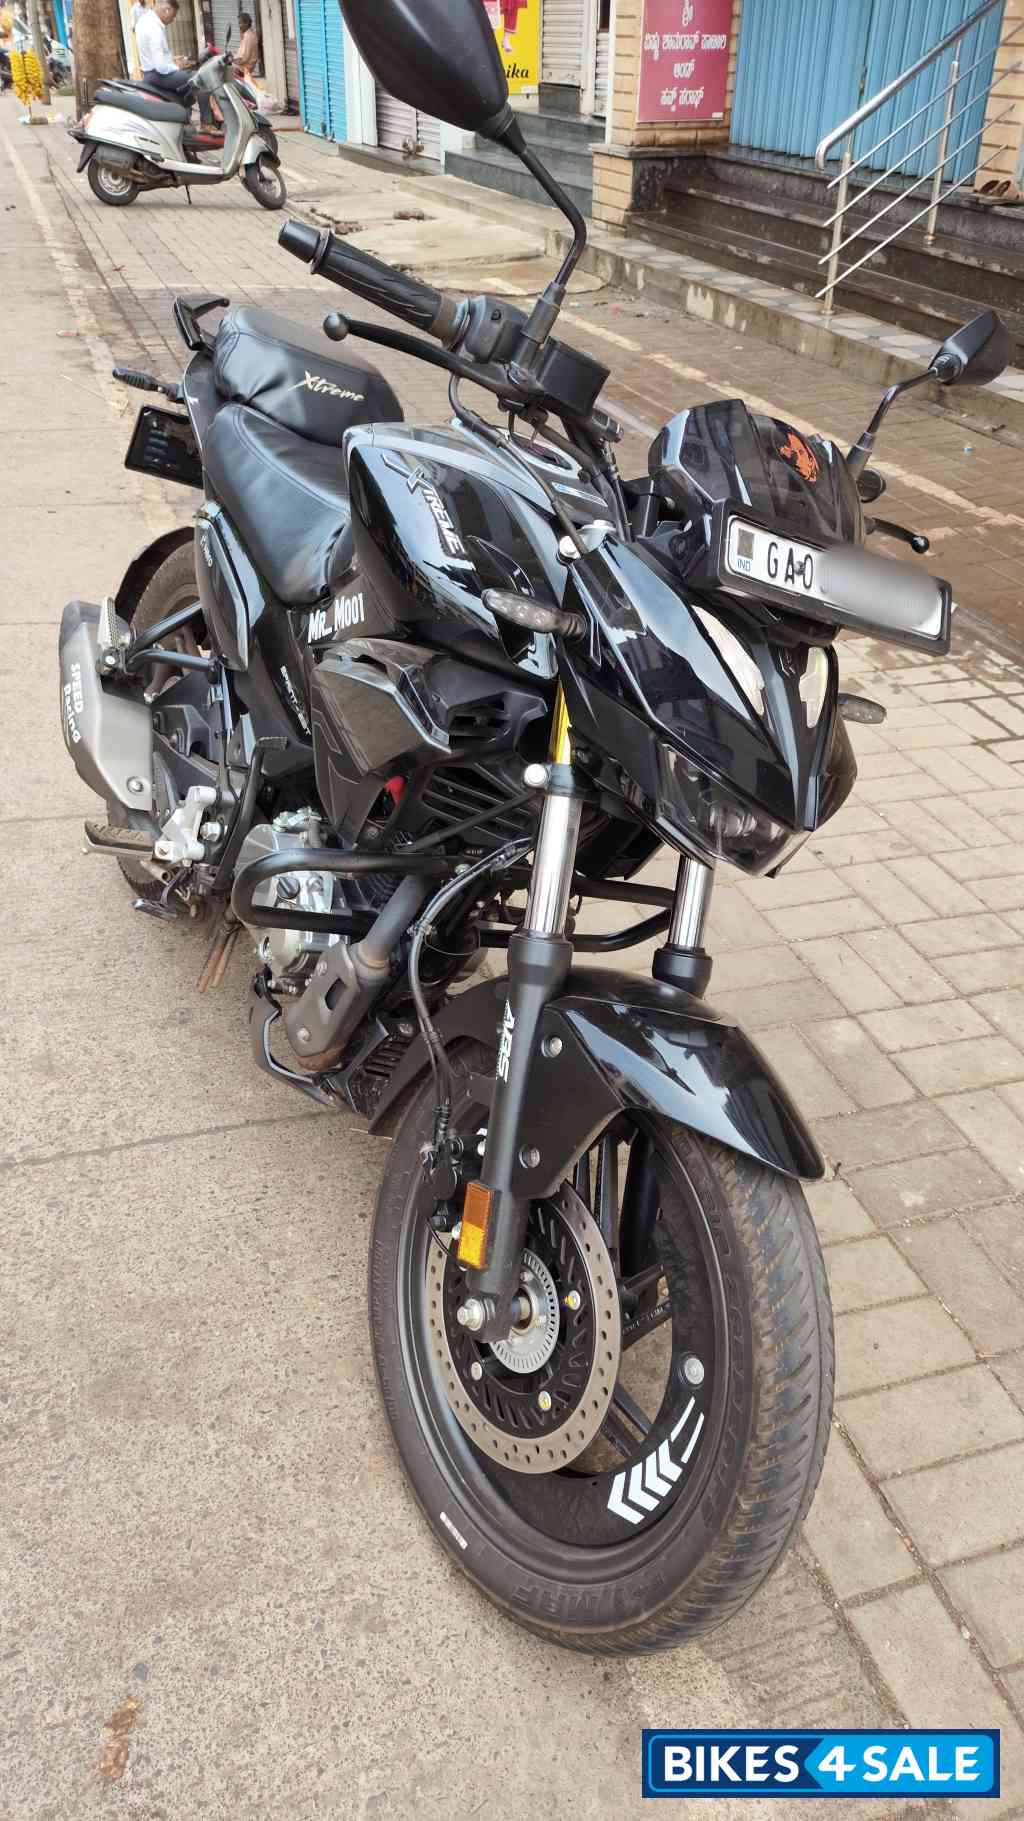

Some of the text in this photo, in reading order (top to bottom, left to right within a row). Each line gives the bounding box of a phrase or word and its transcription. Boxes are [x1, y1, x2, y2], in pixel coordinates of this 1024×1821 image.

[504, 63, 529, 79] ika
[288, 370, 364, 401] Xtreme
[737, 559, 751, 571] IND
[70, 662, 84, 713] SPEED
[498, 999, 515, 1083] ABS
